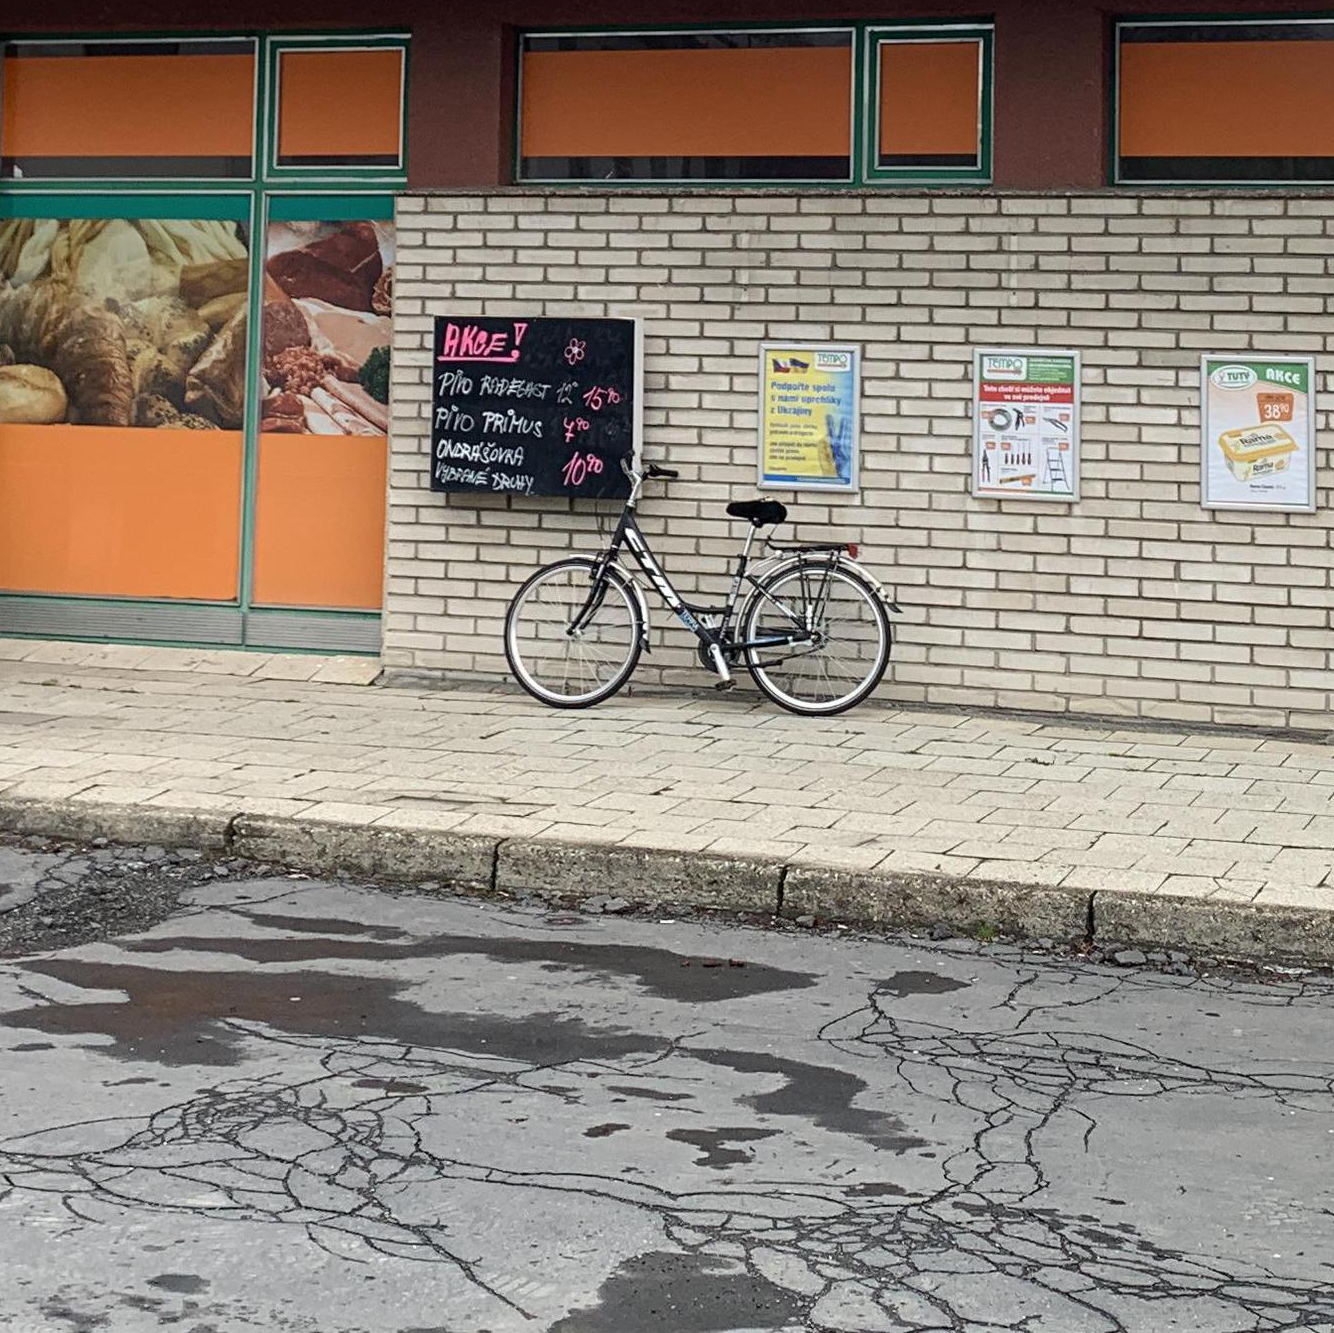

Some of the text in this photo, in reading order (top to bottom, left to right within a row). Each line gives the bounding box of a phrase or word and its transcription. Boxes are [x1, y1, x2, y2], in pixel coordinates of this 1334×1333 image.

[987, 358, 1023, 369] TEMPO
[1227, 372, 1250, 381] TUTY
[1265, 368, 1300, 385] AKCE
